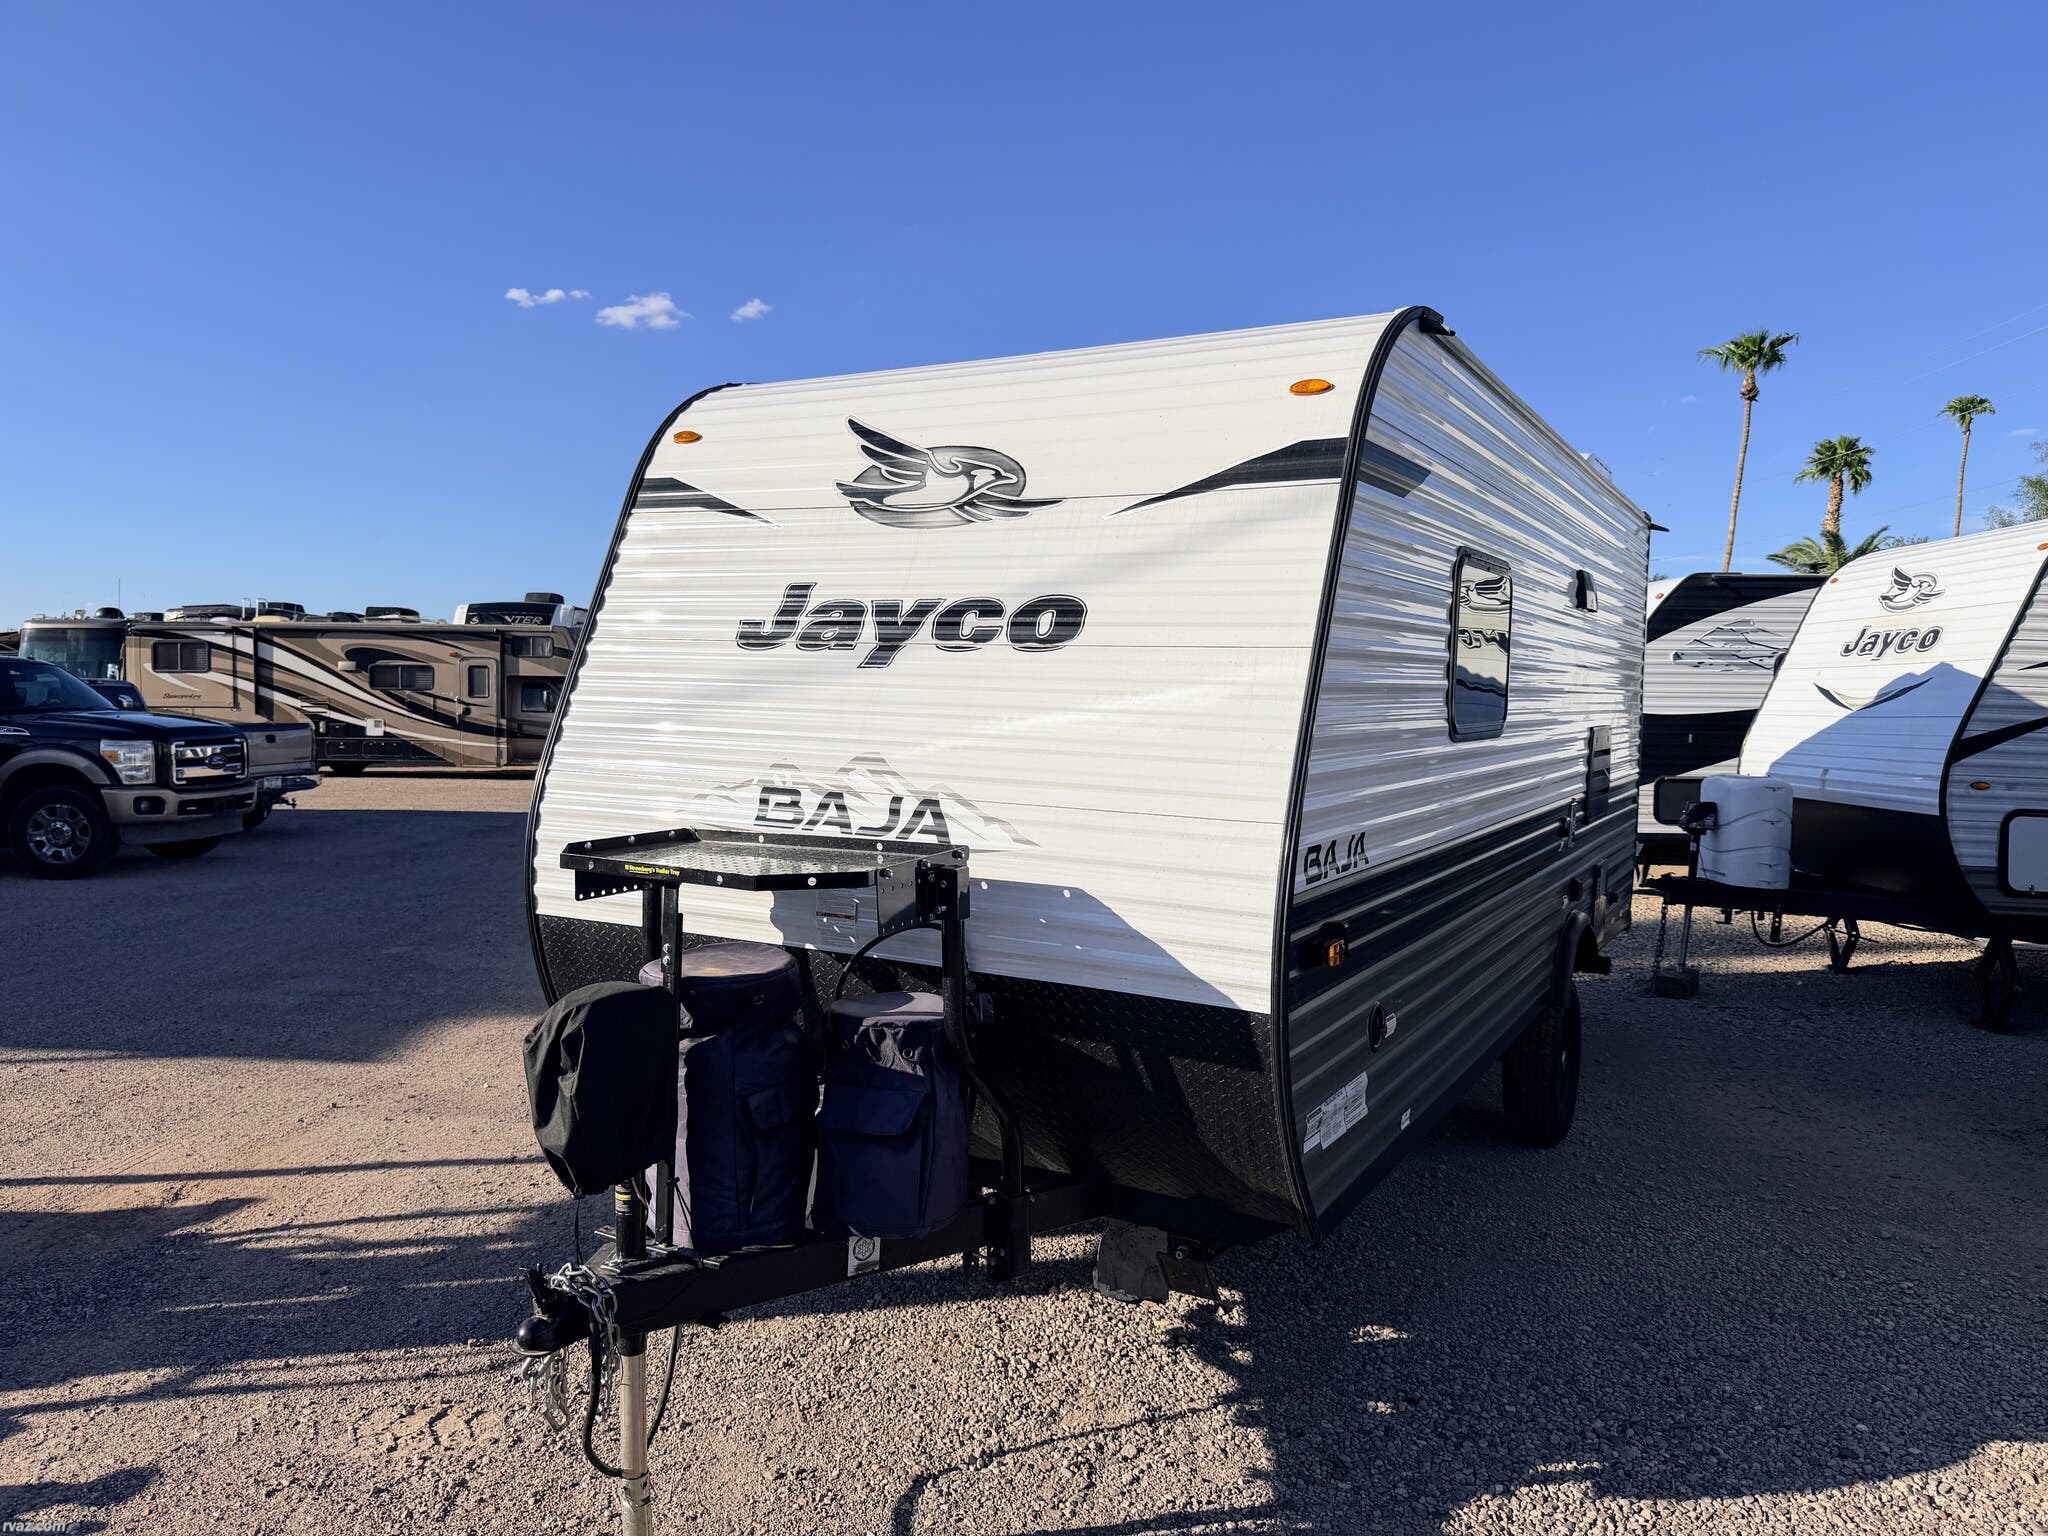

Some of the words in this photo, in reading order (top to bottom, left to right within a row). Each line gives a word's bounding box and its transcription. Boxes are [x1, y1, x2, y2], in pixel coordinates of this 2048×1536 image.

[736, 582, 1089, 669] Jayco
[1840, 625, 1944, 661] Jayco
[753, 786, 952, 845] BAJA
[1303, 831, 1370, 886] BAJA
